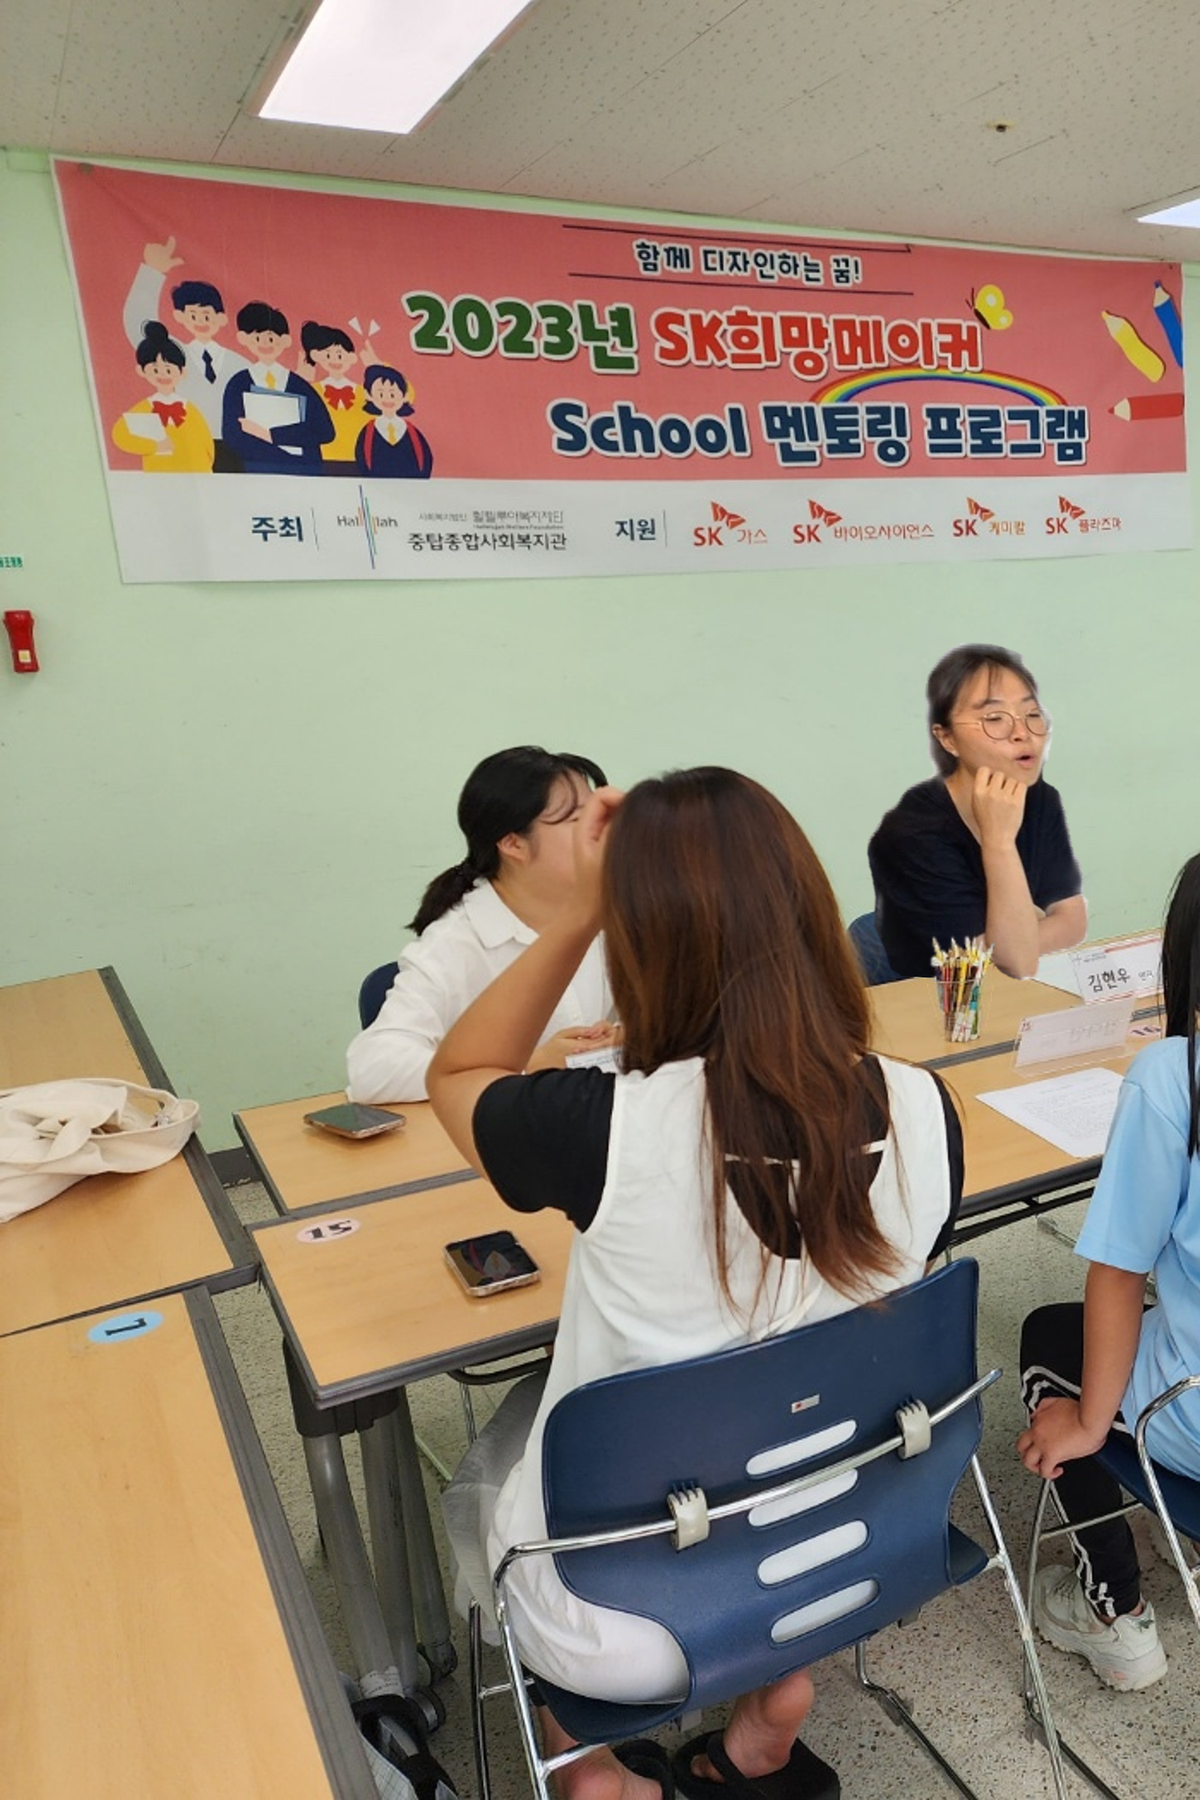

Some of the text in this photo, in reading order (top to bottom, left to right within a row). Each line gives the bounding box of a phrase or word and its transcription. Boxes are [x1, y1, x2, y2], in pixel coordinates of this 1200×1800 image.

[635, 242, 863, 285] 함께 디자인하는 꿈!
[405, 294, 982, 379] 2023년 SK희망메이커
[550, 402, 1089, 465] School 멘토링 프로그램
[251, 516, 304, 543] 주최
[615, 518, 656, 541] 지원
[693, 526, 769, 547] SK 가스
[793, 524, 935, 544] SK 바이오사이언스
[952, 518, 978, 537] SK
[1045, 517, 1069, 535] SK
[408, 533, 567, 551] 중탑종합사회복지관
